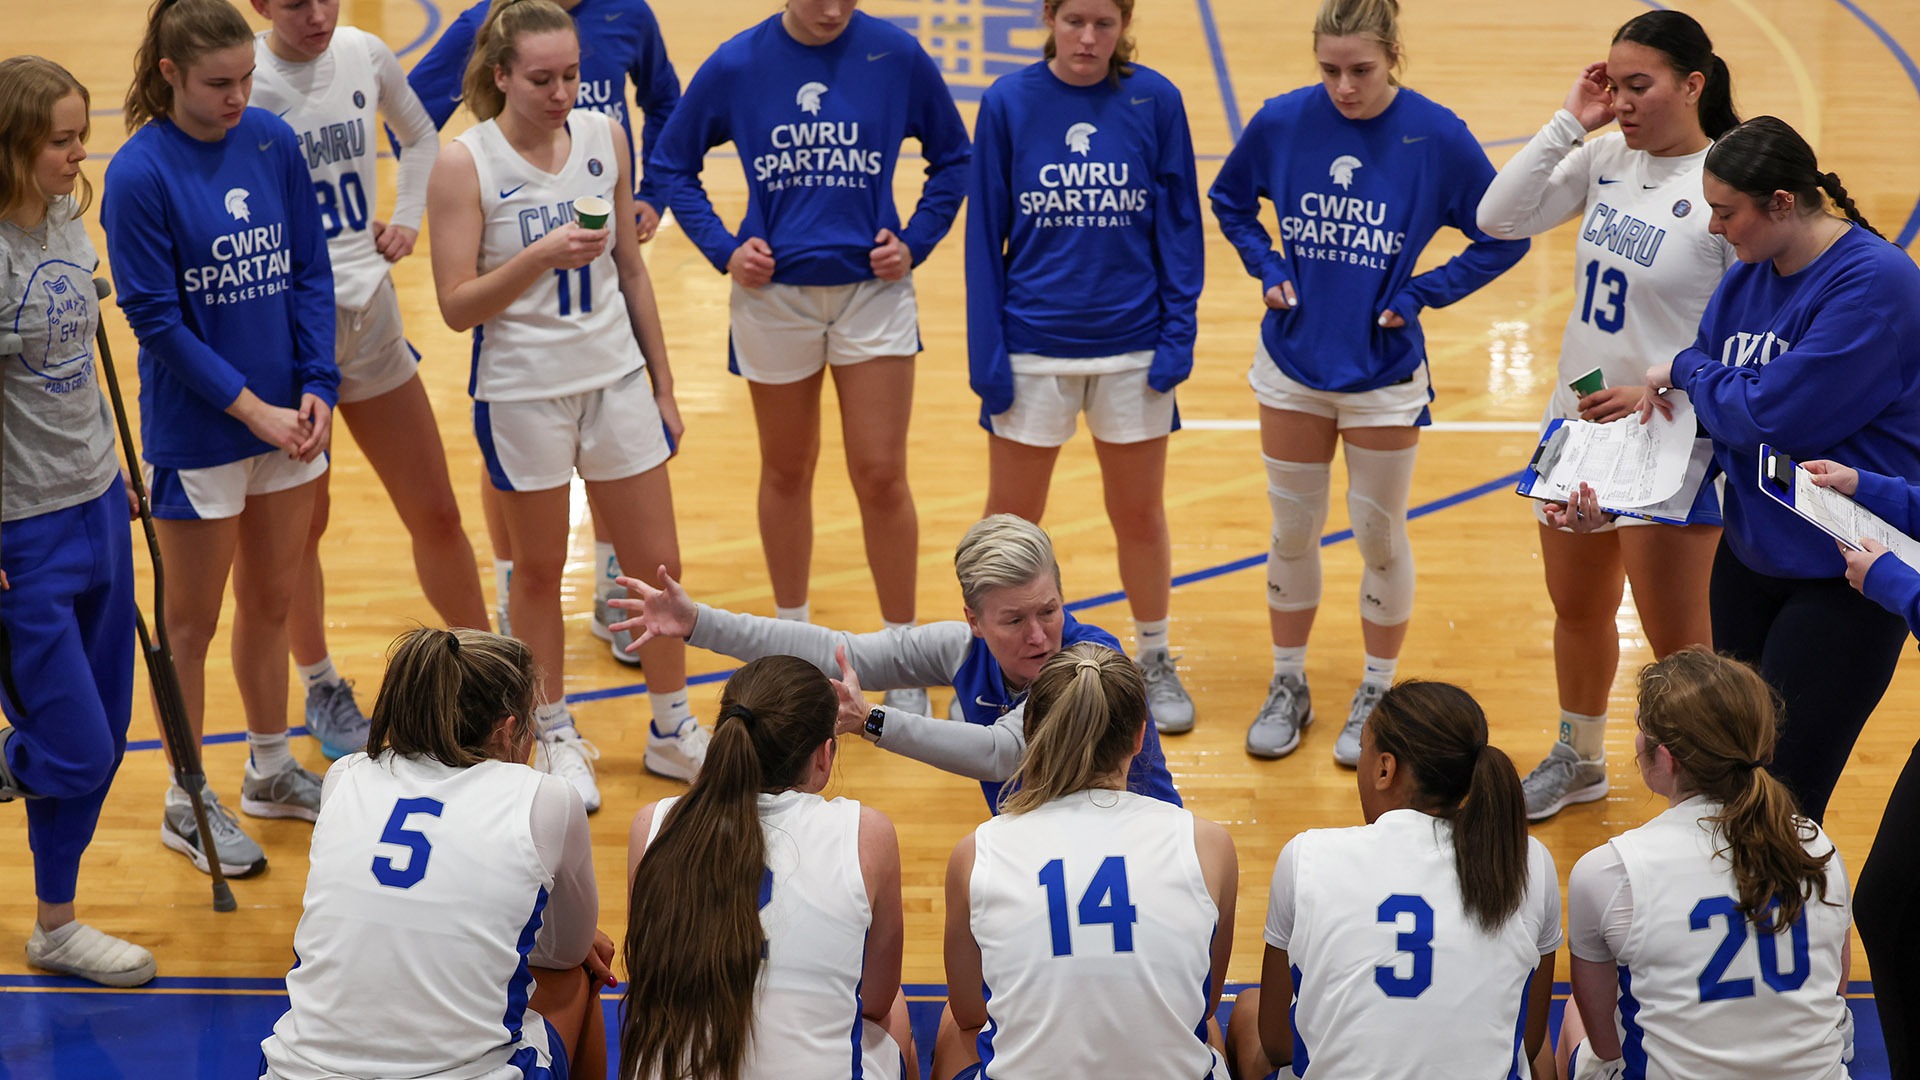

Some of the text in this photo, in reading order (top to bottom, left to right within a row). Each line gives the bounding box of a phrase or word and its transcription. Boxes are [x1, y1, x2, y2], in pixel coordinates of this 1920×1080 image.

[577, 79, 611, 106] RU
[297, 118, 366, 169] WRU
[771, 122, 858, 149] CWRU
[753, 148, 882, 181] SPARTANS
[767, 175, 867, 192] BASKETBALL
[1039, 162, 1128, 188] CWRU
[1020, 189, 1147, 215] SPARTANS
[1300, 192, 1387, 226] CWRU
[211, 222, 282, 261] CWRU
[1281, 216, 1405, 255] SPARTANS
[1583, 202, 1666, 268] CWRU
[184, 249, 290, 292] SPARTAN
[205, 278, 289, 305] BASKETBAL
[554, 265, 592, 316] 11
[1581, 259, 1628, 335] 13
[60, 320, 78, 343] 54
[370, 796, 445, 890] 5
[1038, 855, 1138, 958] 14
[1373, 893, 1434, 998] 3
[1688, 893, 1811, 1003] 20
